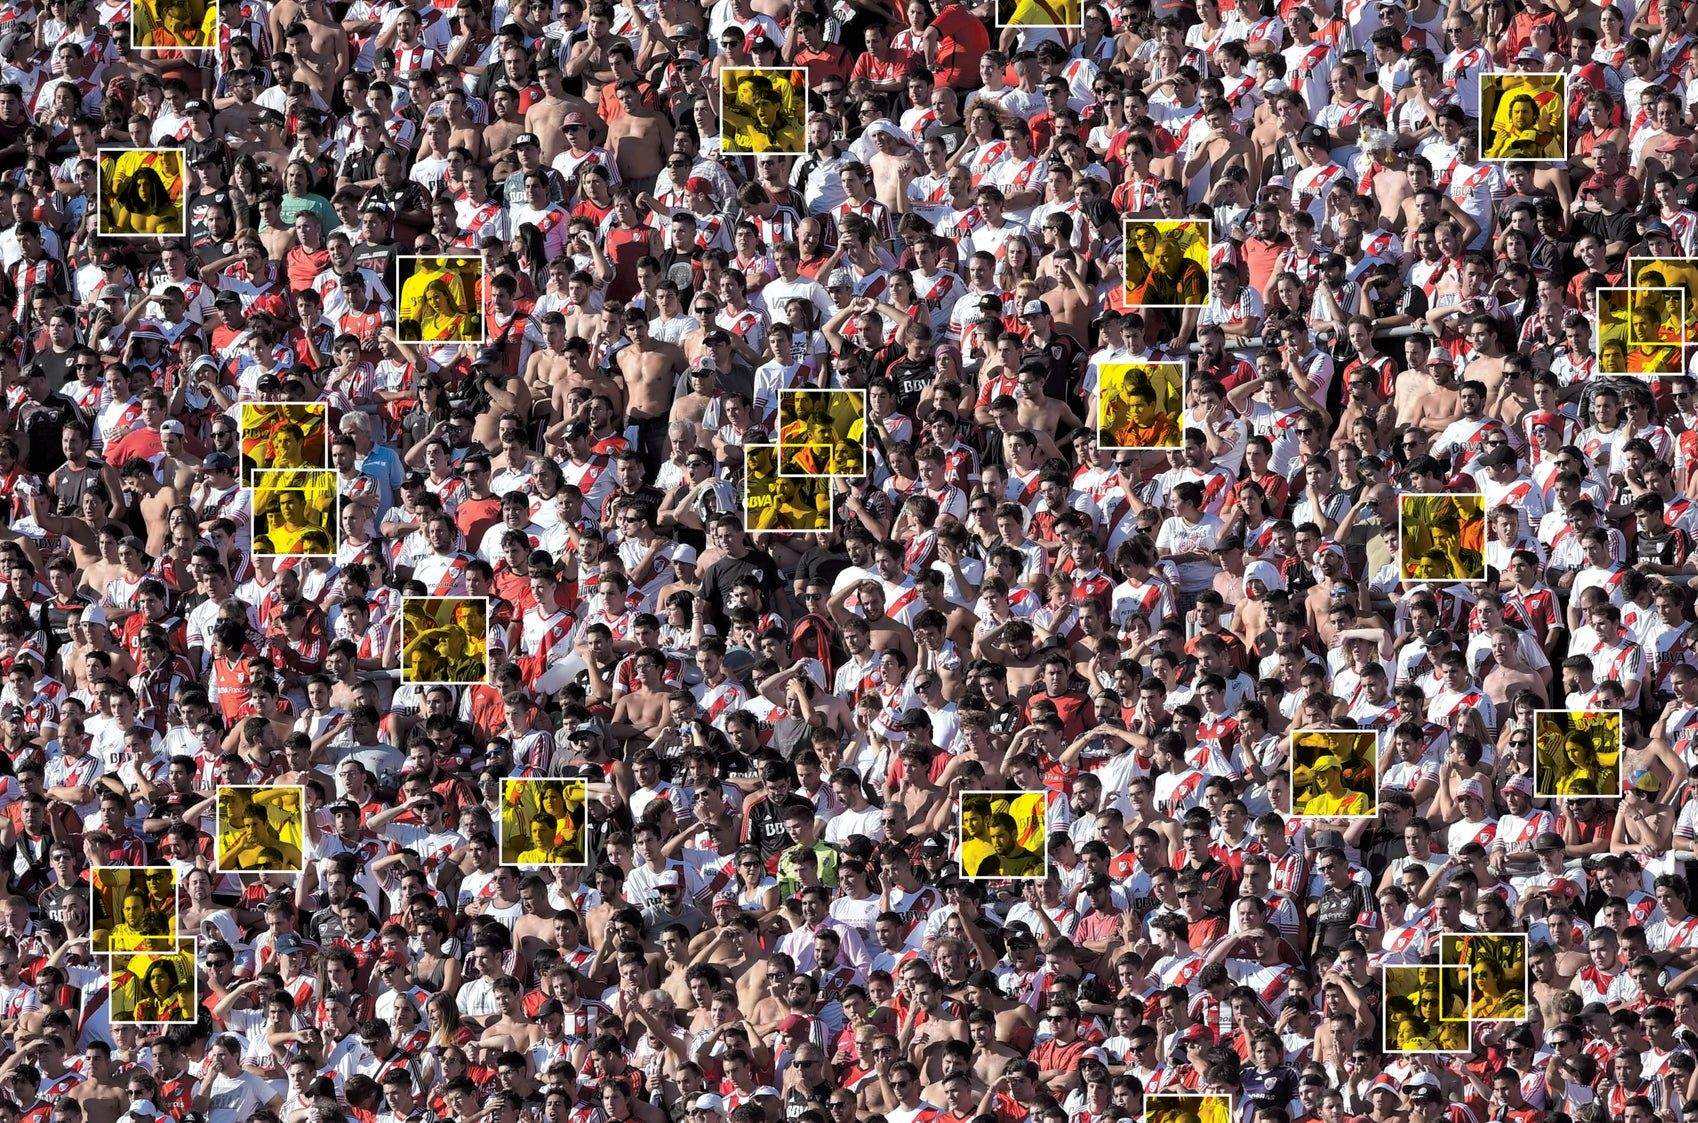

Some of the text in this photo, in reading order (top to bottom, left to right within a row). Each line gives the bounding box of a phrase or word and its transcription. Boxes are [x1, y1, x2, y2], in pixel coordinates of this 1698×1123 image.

[1288, 69, 1312, 79] BBVA
[945, 228, 972, 239] BBVA
[1453, 441, 1484, 454] BBVA
[746, 495, 773, 508] BVA
[1655, 651, 1685, 663] BBVA
[766, 822, 785, 837] BB
[1505, 841, 1534, 852] BBVA
